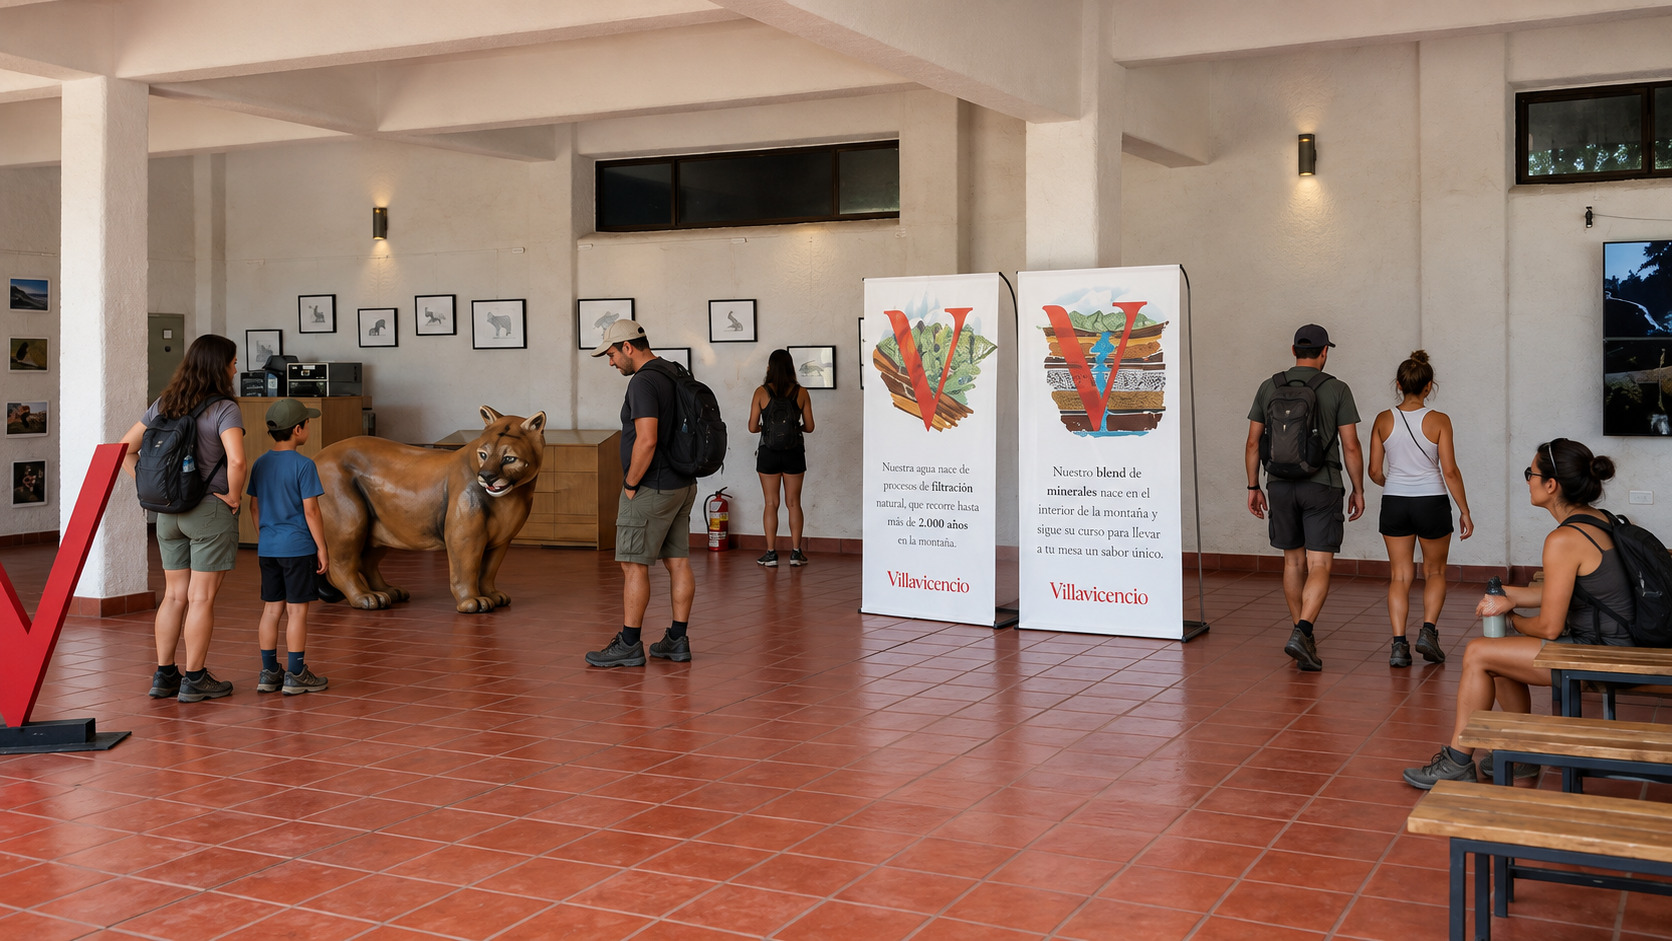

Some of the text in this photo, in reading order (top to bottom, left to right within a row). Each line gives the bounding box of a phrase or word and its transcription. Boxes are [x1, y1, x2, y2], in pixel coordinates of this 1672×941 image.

[884, 307, 974, 432] V
[1042, 301, 1148, 431] V
[882, 462, 970, 476] Nuestra agua nace de
[1053, 466, 1142, 479] Nuestro blend de
[883, 481, 973, 493] procesos de filtración
[1047, 486, 1150, 499] minerales nace en el
[876, 498, 980, 512] natural, que recorre hasta
[1038, 504, 1158, 522] interior de la montaña y
[887, 516, 969, 530] más de 2.000 años
[1037, 524, 1161, 541] sigue su curso para llevar
[897, 535, 957, 548] en la montaña.
[1036, 545, 1164, 559] a tu mesa un sabor único.
[887, 570, 970, 593] Villavicencio
[1050, 581, 1149, 605] Villavicencio
